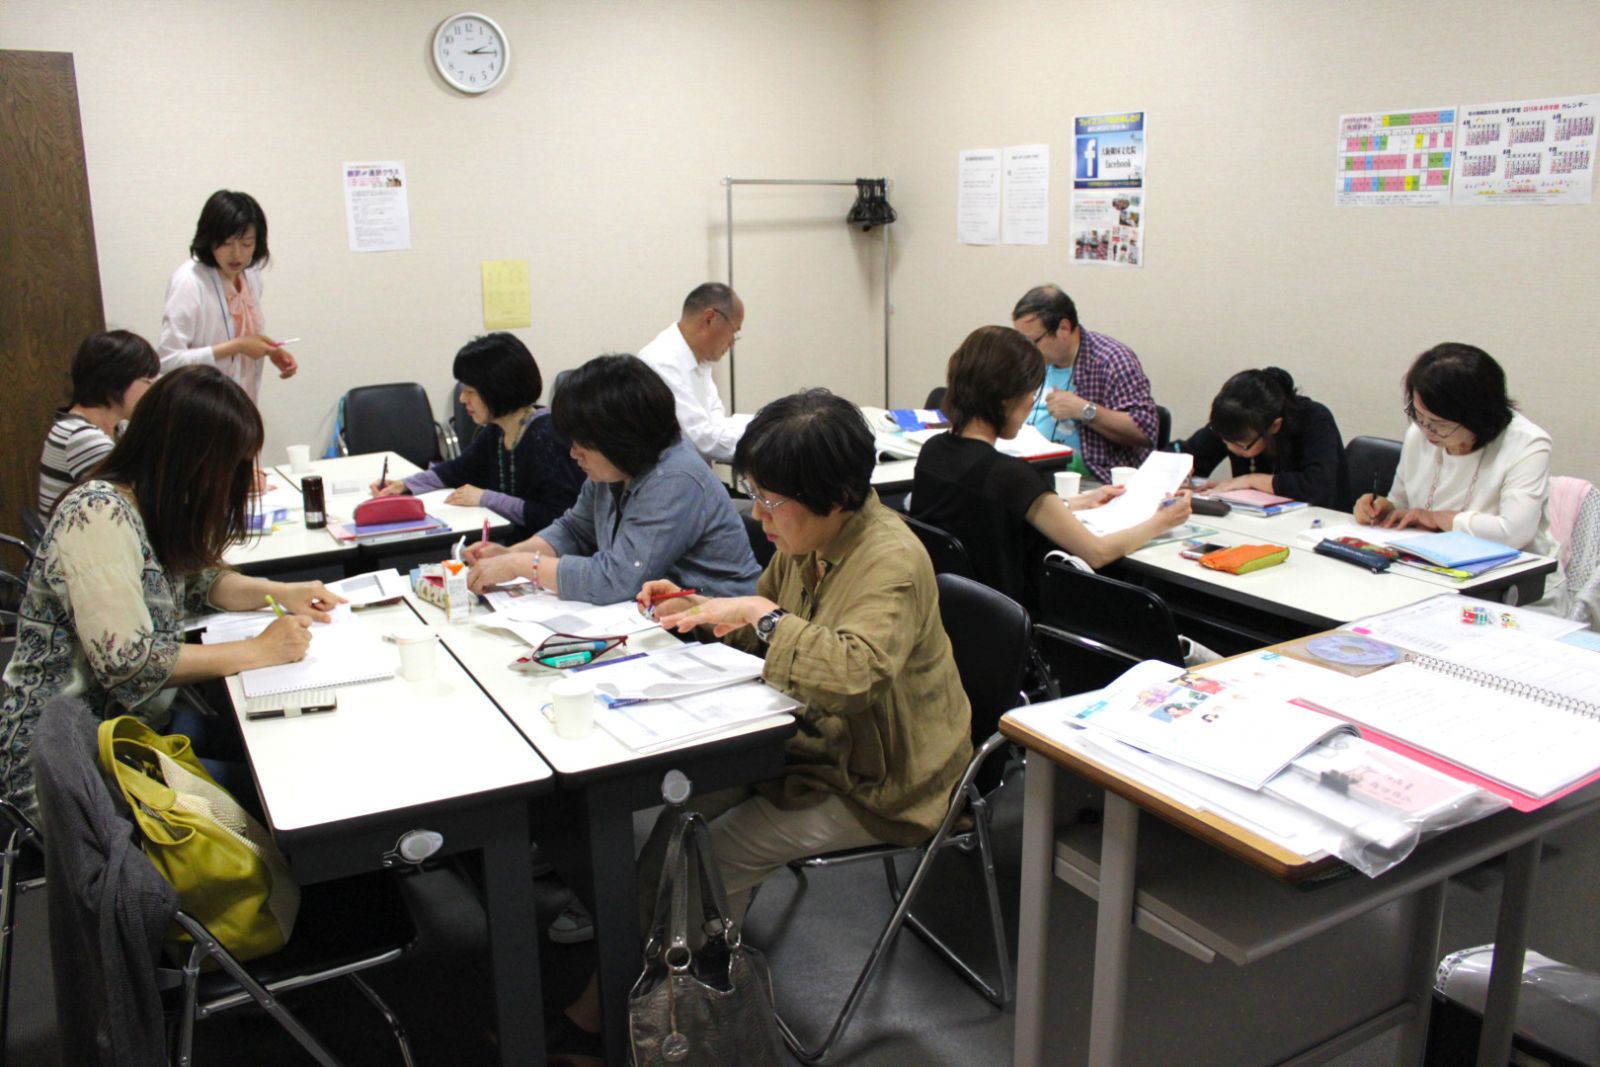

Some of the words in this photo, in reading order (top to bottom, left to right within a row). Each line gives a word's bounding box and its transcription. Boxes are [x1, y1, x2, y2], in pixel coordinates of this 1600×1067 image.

[454, 26, 461, 35] 11
[465, 23, 473, 32] 12
[480, 26, 484, 35] 1
[446, 35, 454, 44] 10
[489, 62, 494, 71] 4
[458, 71, 464, 80] 7
[470, 74, 476, 82] 6
[482, 71, 487, 80] 5
[1105, 158, 1131, 168] facebook
